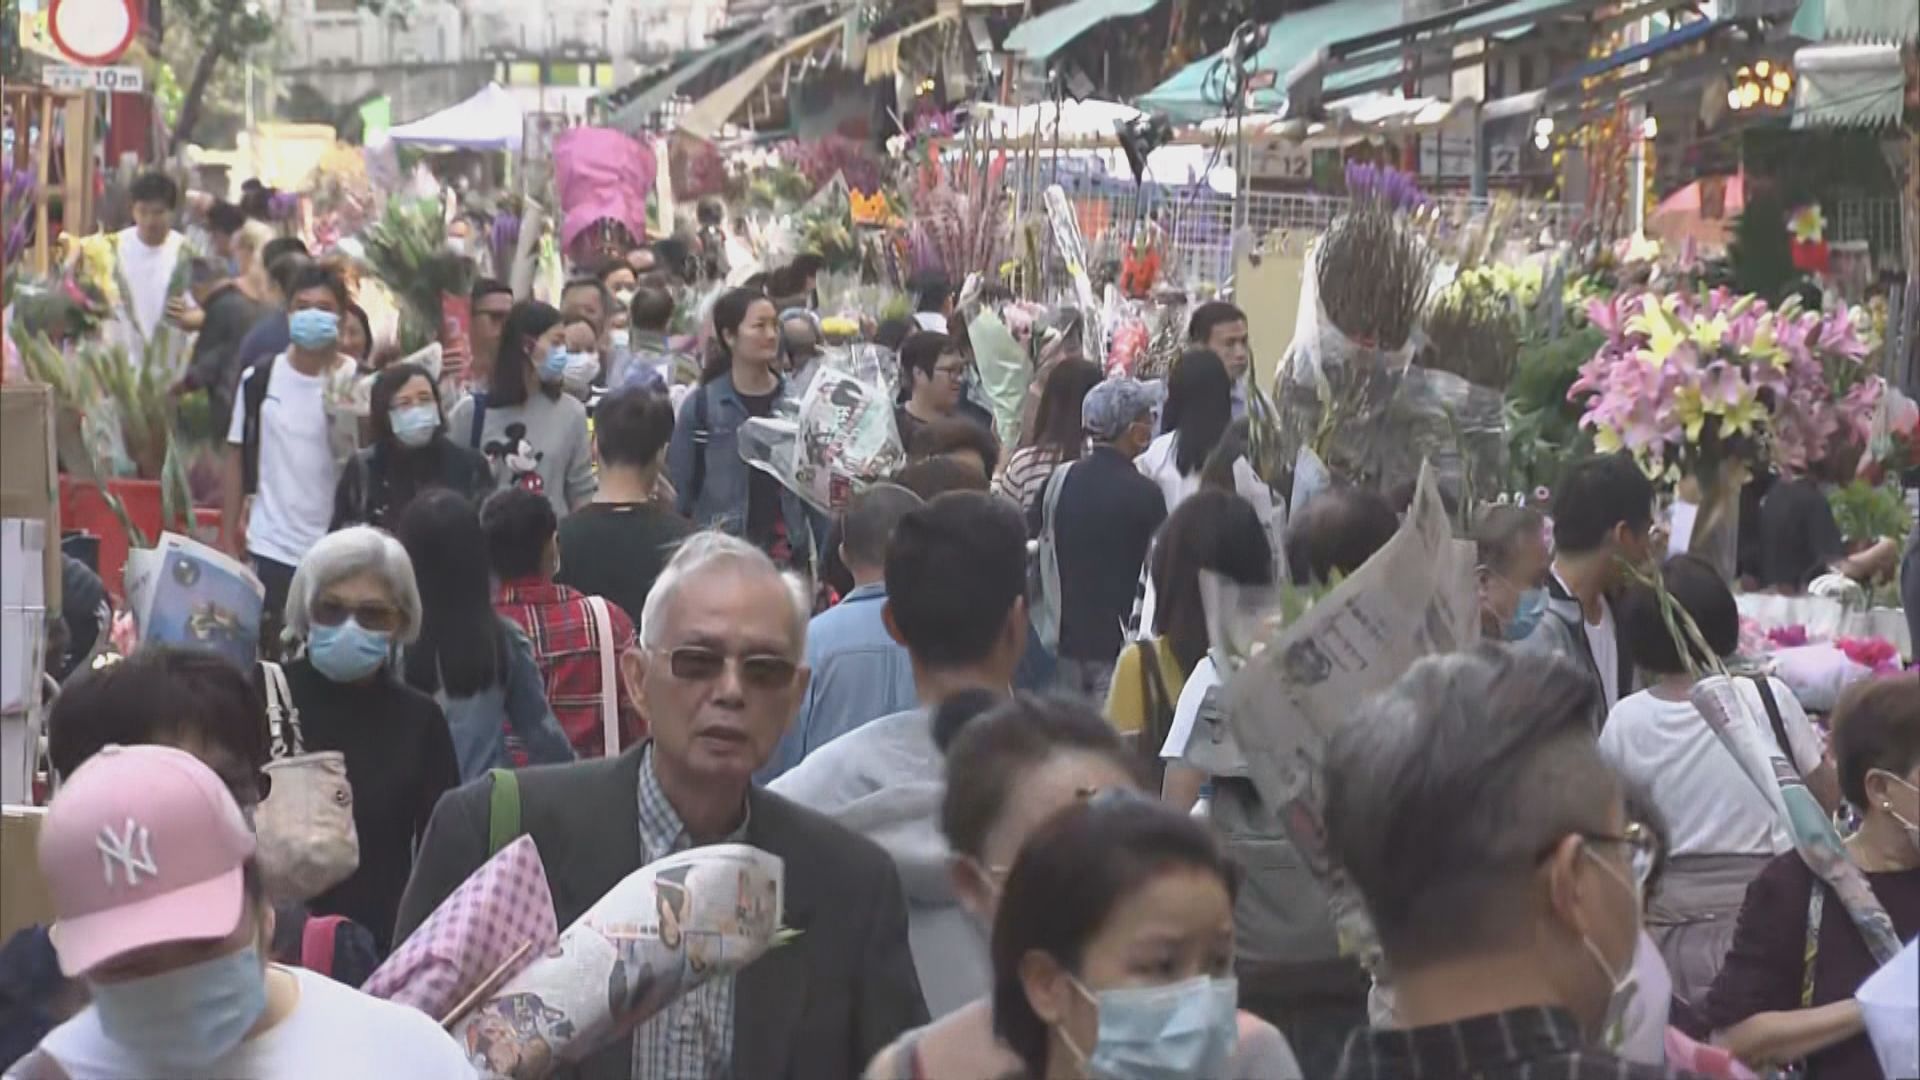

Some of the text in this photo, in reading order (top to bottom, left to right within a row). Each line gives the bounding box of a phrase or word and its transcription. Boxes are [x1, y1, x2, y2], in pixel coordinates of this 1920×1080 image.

[95, 70, 117, 87] 10
[121, 74, 138, 86] m
[95, 817, 158, 887] NY
